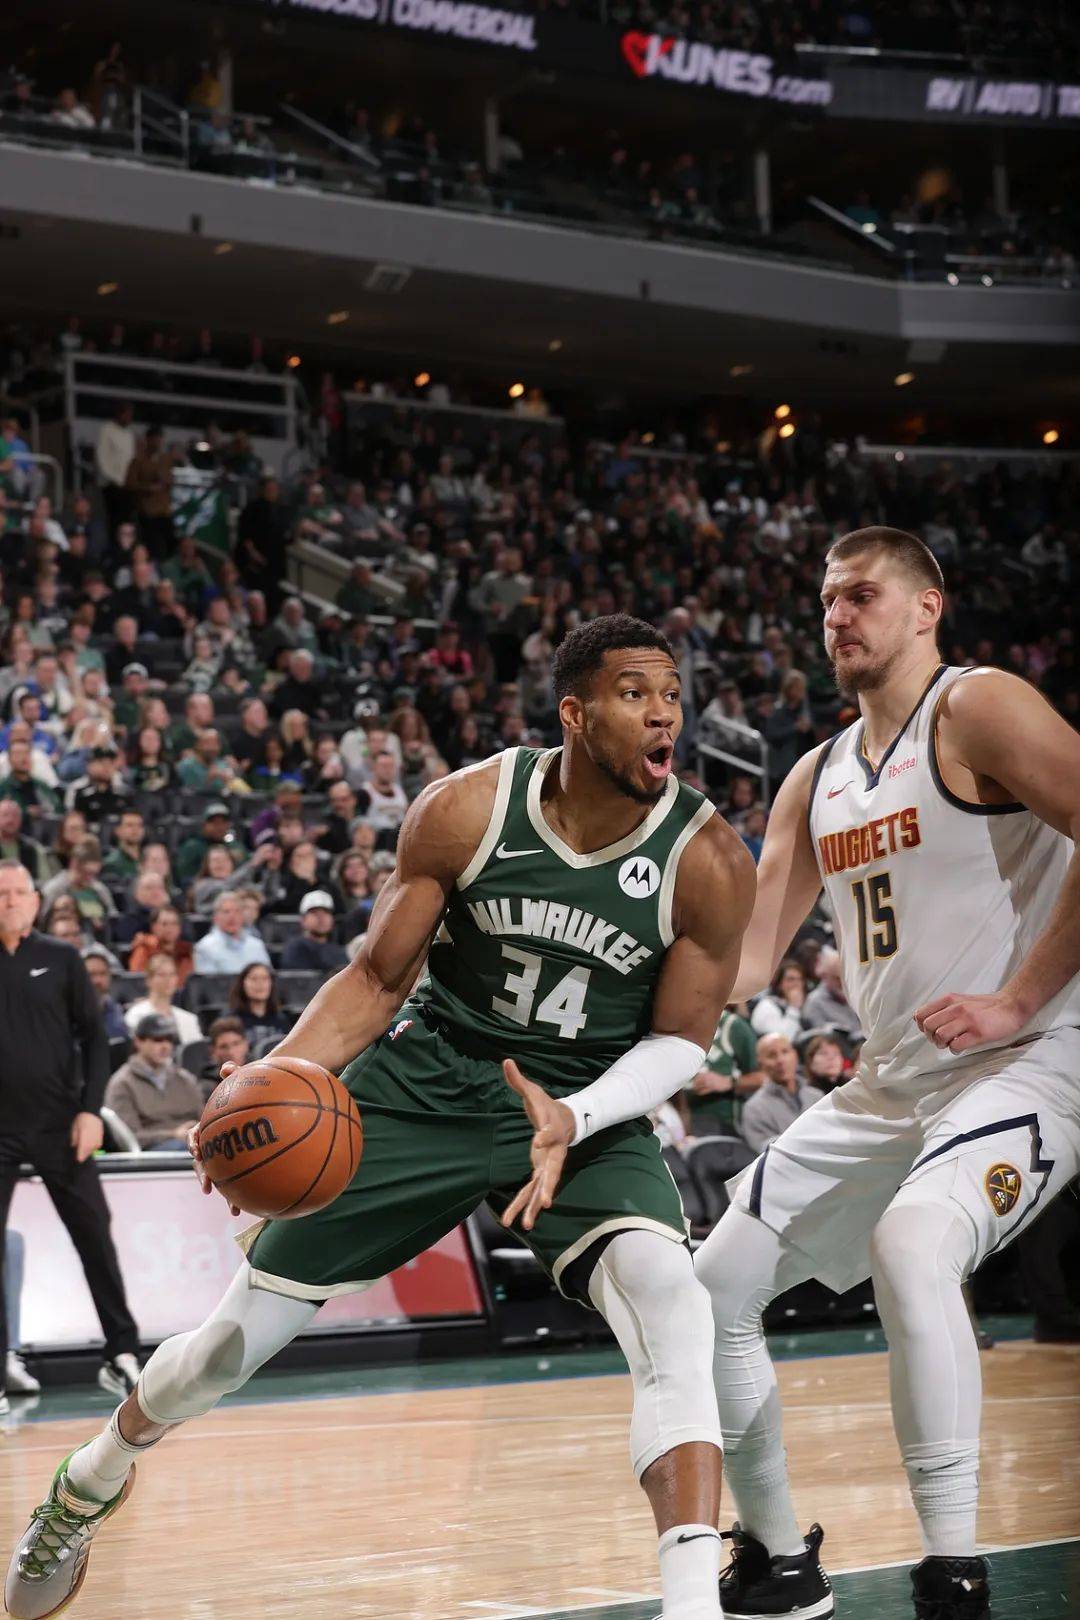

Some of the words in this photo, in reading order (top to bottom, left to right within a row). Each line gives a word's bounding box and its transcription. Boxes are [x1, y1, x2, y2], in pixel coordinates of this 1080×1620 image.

[393, 0, 537, 50] COMMERCIAL
[926, 78, 965, 110] RV
[976, 82, 1042, 114] AUTO
[887, 756, 917, 779] ibotta
[819, 807, 921, 875] NUGGETS
[851, 872, 900, 965] 15
[492, 943, 592, 1040] 34
